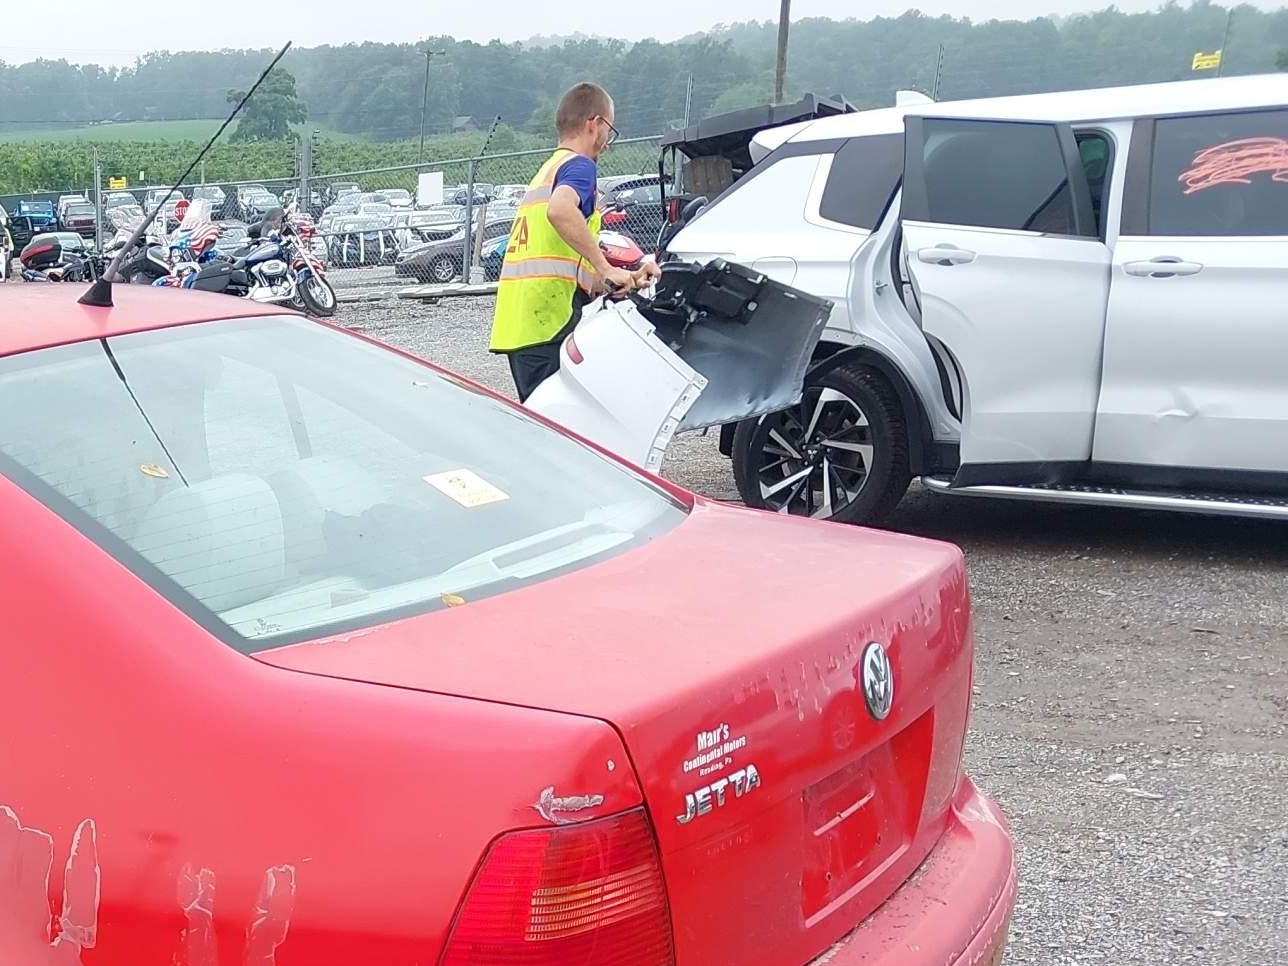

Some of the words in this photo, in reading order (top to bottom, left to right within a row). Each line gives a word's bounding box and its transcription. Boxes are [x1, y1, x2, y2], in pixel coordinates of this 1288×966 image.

[683, 744, 723, 773] Continental
[723, 735, 746, 754] Motors
[675, 763, 762, 825] JETTA
